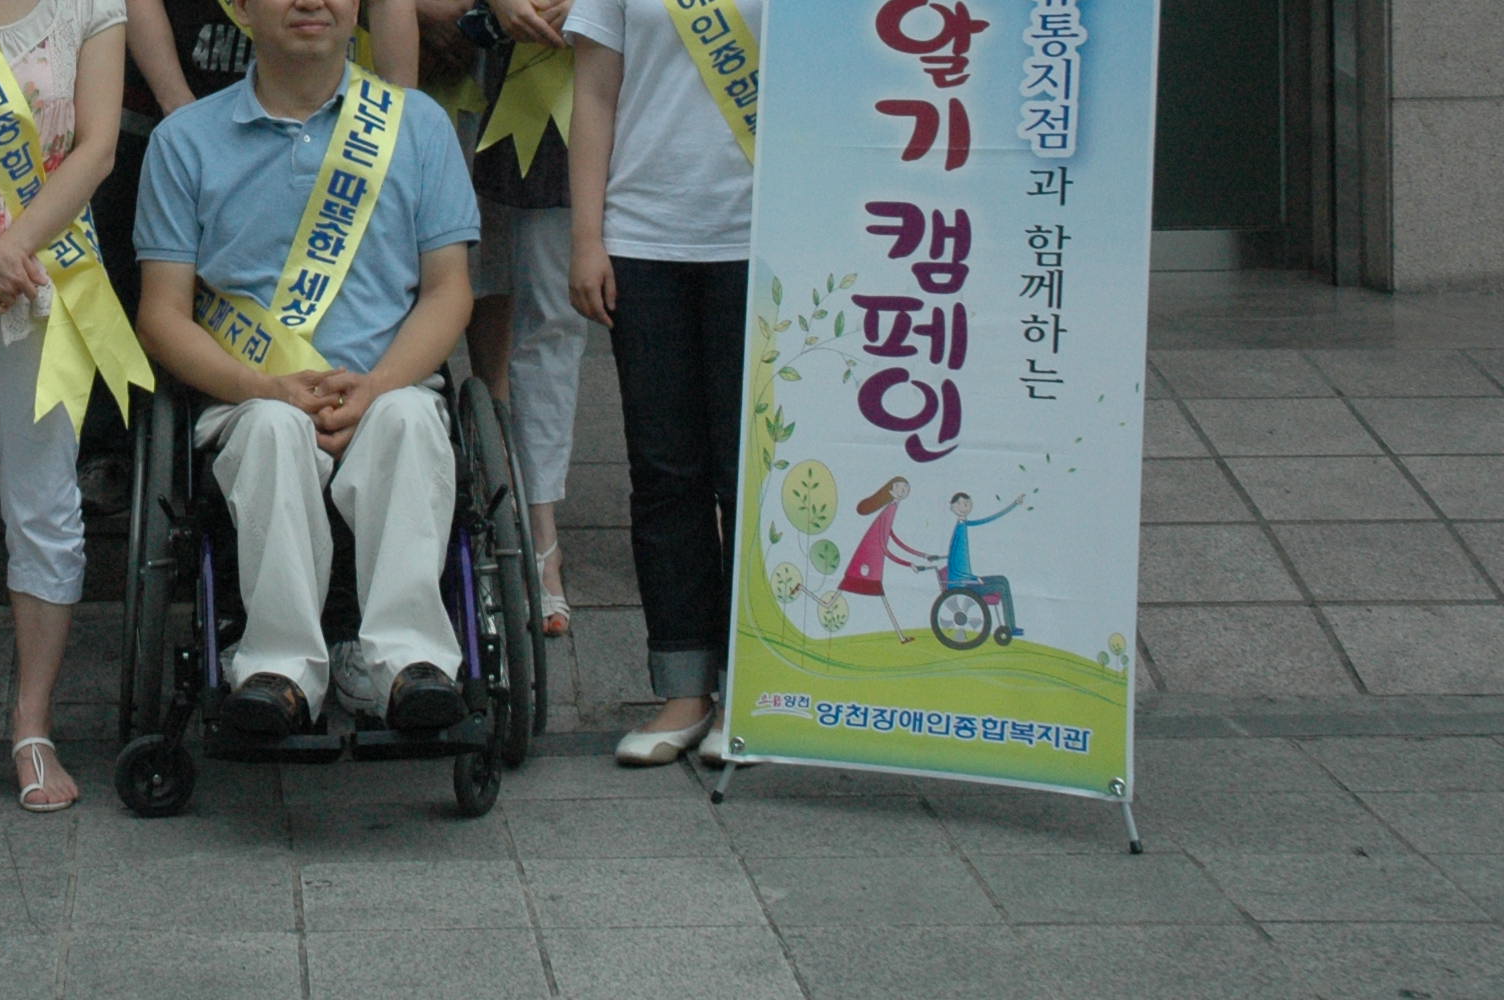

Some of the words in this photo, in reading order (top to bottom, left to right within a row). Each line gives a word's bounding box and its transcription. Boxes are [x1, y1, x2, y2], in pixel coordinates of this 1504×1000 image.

[342, 79, 391, 168] 나누는
[306, 168, 368, 265] 따뜻한
[280, 268, 331, 326] 세상
[850, 201, 973, 464] 캠페인
[1018, 224, 1072, 400] 함께하는
[816, 702, 1091, 752] 양천장애인종합복지관
